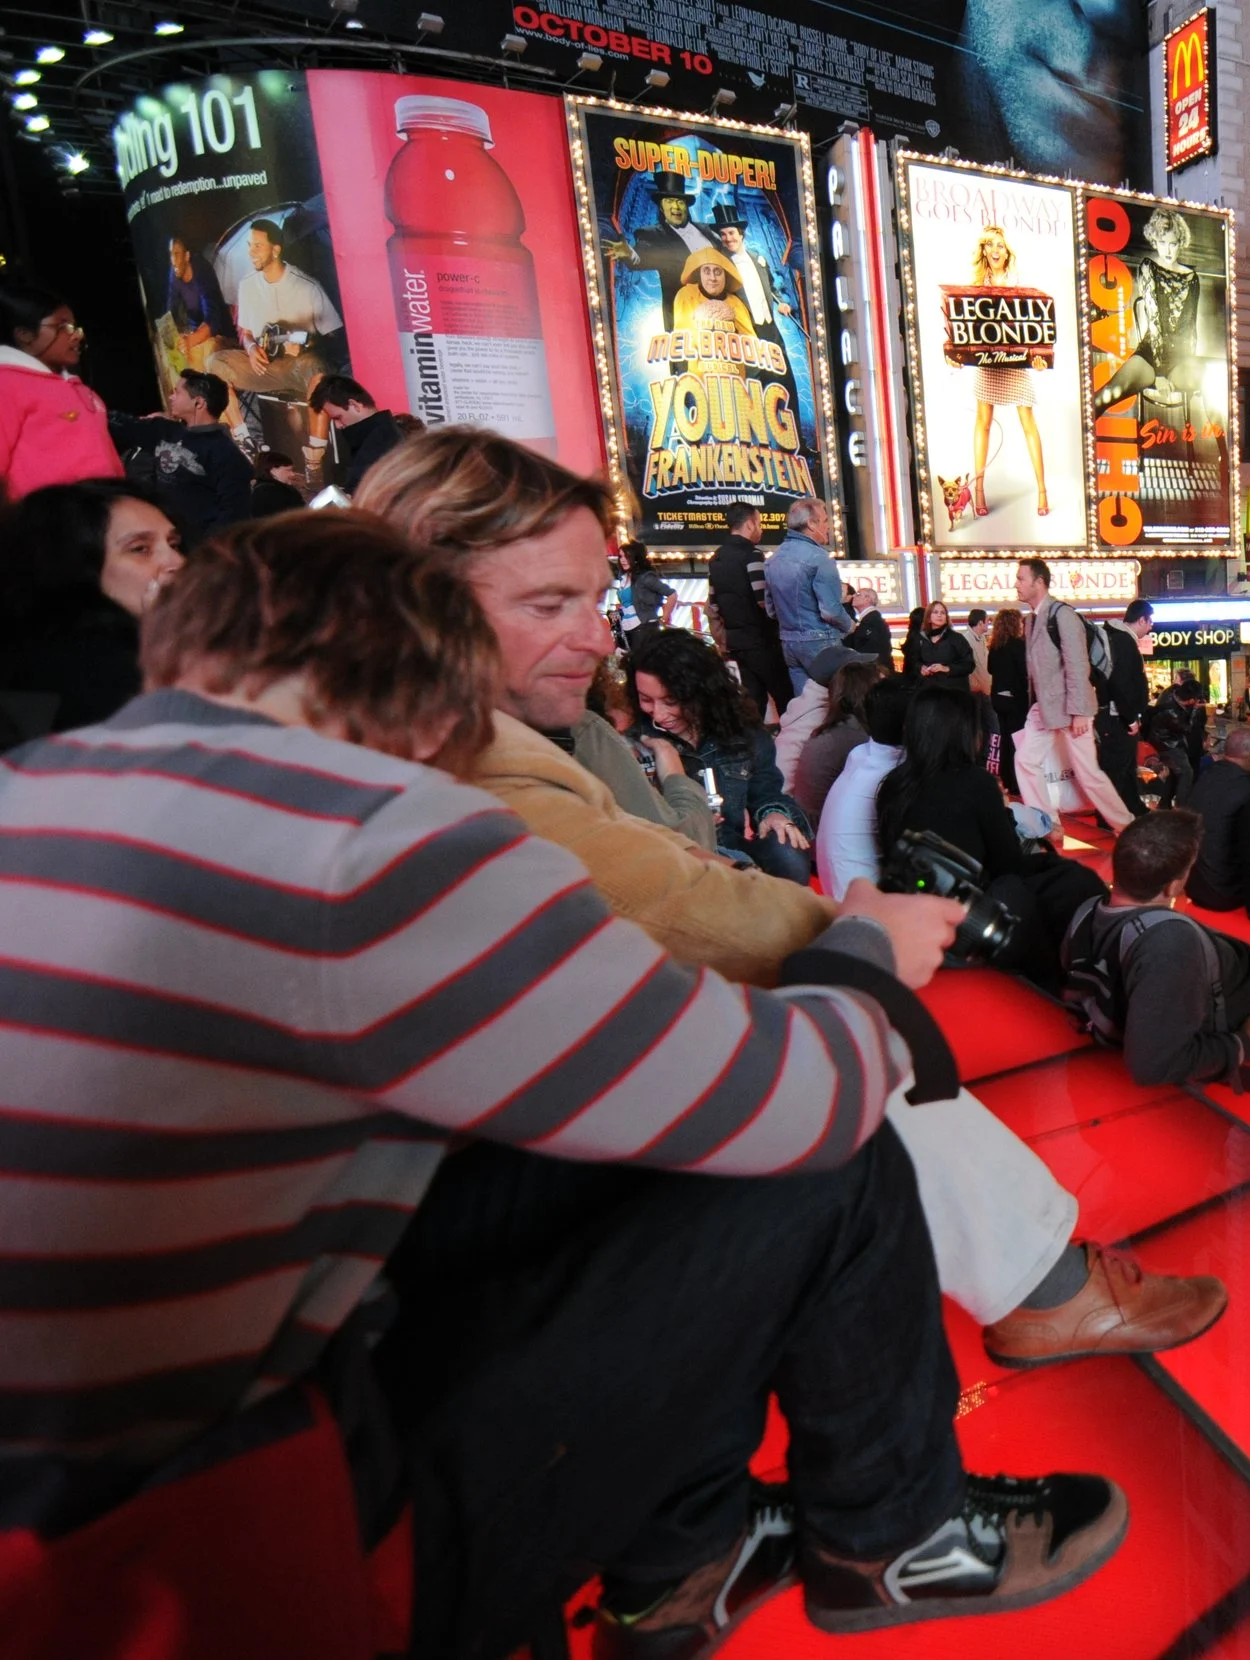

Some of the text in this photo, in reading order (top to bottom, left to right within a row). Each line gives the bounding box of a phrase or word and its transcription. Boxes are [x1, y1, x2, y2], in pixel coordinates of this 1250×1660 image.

[513, 6, 713, 75] OCTOBER 10
[515, 26, 629, 60] www.body-of-lies.com
[547, 2, 583, 22] WILLIAM
[584, 9, 625, 33] MONAHAN
[654, 27, 683, 49] DONALD
[747, 53, 769, 73] RIDLEY
[770, 60, 790, 78] SCOTT
[641, 8, 682, 32] ALEXANDER
[683, 20, 700, 38] WITT
[732, 34, 760, 56] MICHAEL
[762, 43, 794, 66] COSTIGAN
[796, 53, 824, 74] CHARLES
[653, 0, 678, 16] SIMON
[769, 29, 788, 49] YATES
[805, 42, 824, 59] MARC
[880, 64, 900, 81] PIETRO
[731, 4, 767, 28] LEONARDO
[800, 25, 825, 47] RUSSELL
[827, 32, 847, 53] CROWE
[870, 46, 877, 61] OF
[895, 55, 912, 72] MARK
[913, 60, 934, 80] STRONG
[795, 73, 810, 90] R
[894, 82, 910, 99] DAVID
[1175, 87, 1202, 115] OPEN
[180, 85, 262, 156] 101
[1178, 106, 1200, 138] 24
[1173, 127, 1209, 157] HOURS
[613, 137, 777, 191] SUPER-DUPER!
[916, 177, 1064, 221] BROADWAY
[916, 201, 972, 224] GOES
[436, 272, 480, 284] power-c
[828, 165, 866, 468] PALACE
[949, 297, 1053, 321] LEGALLY
[1117, 286, 1126, 334] MUSICAL
[952, 321, 1056, 345] BLONDE
[647, 330, 787, 375] MEL BROOKS
[975, 350, 1028, 365] The Musical
[457, 413, 468, 421] 20
[649, 373, 800, 453] YOUNG
[1140, 418, 1177, 449] Sin
[1182, 422, 1197, 442] is
[643, 443, 816, 498] FRANKENSTEIN
[657, 512, 728, 522] TICKETMASTER.
[948, 573, 1129, 590] LEGAL BLONDE
[1151, 630, 1234, 648] BODY SHOP
